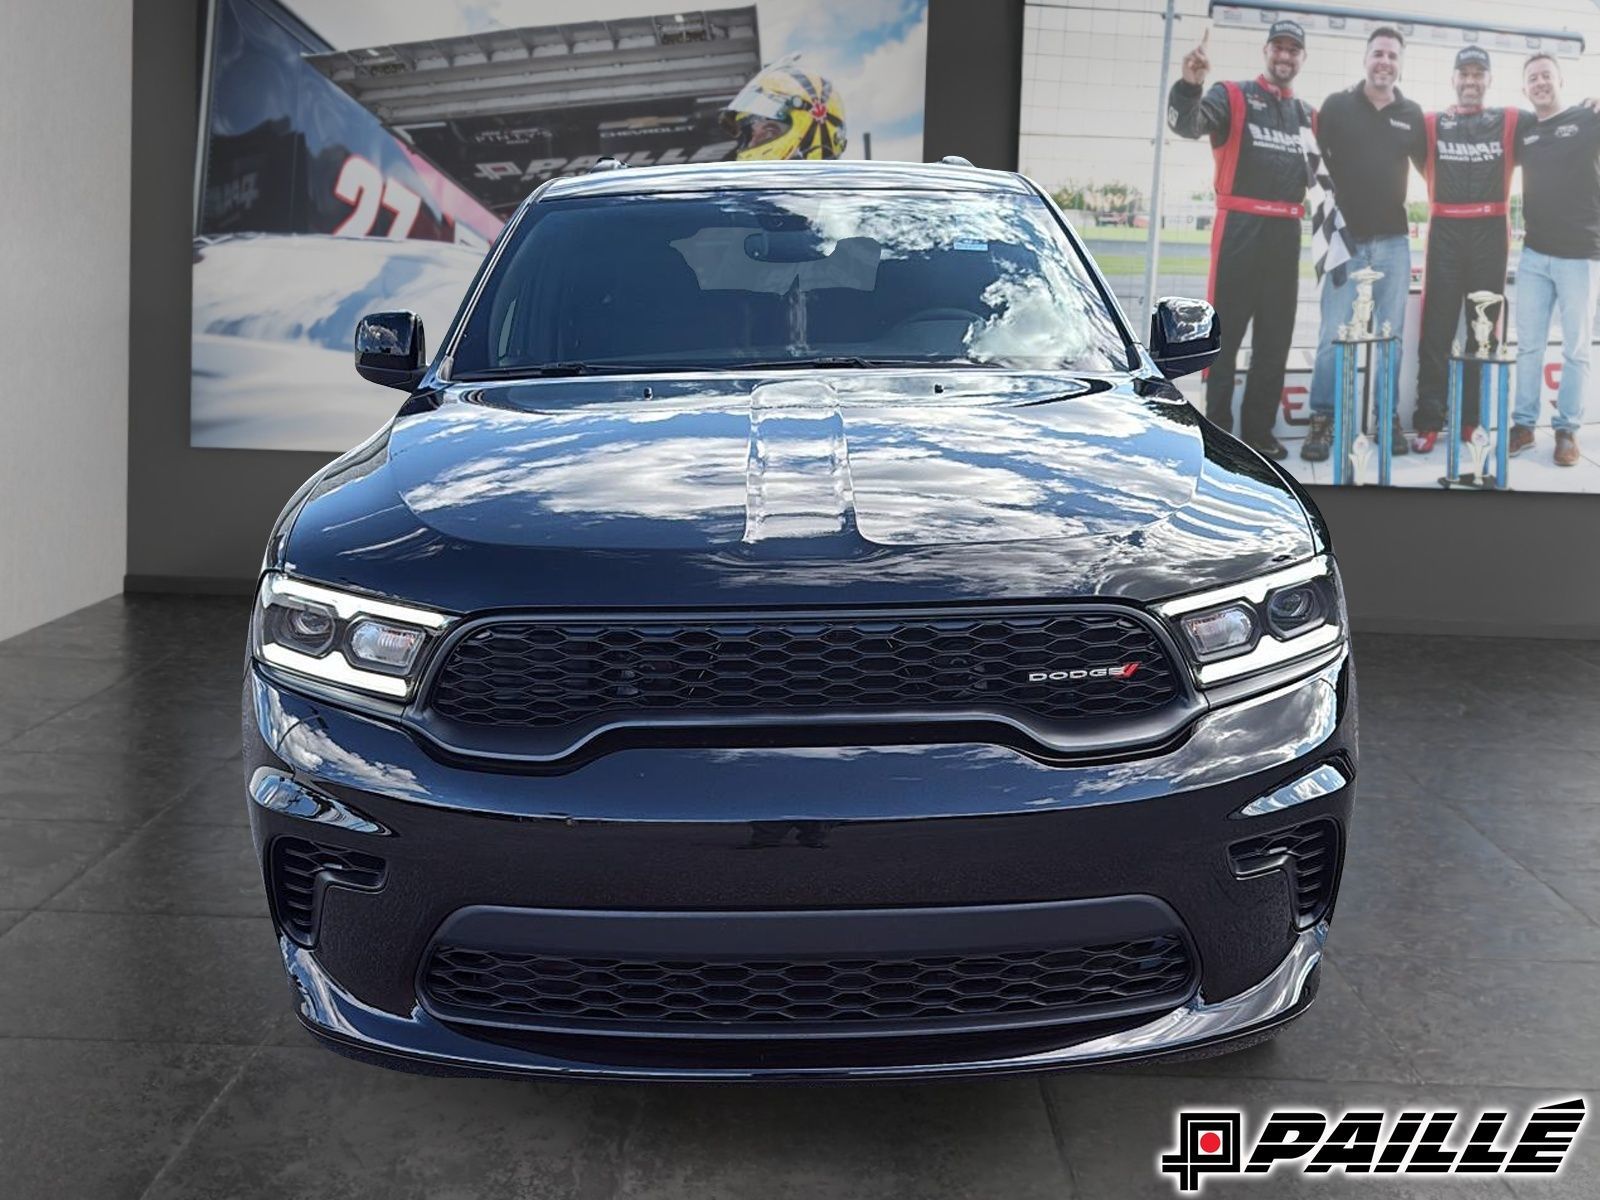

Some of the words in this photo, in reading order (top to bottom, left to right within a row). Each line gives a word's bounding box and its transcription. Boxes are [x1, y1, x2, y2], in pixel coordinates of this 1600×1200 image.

[600, 125, 696, 139] CHEVROLET
[333, 155, 421, 240] 27
[1028, 666, 1126, 682] DODGE
